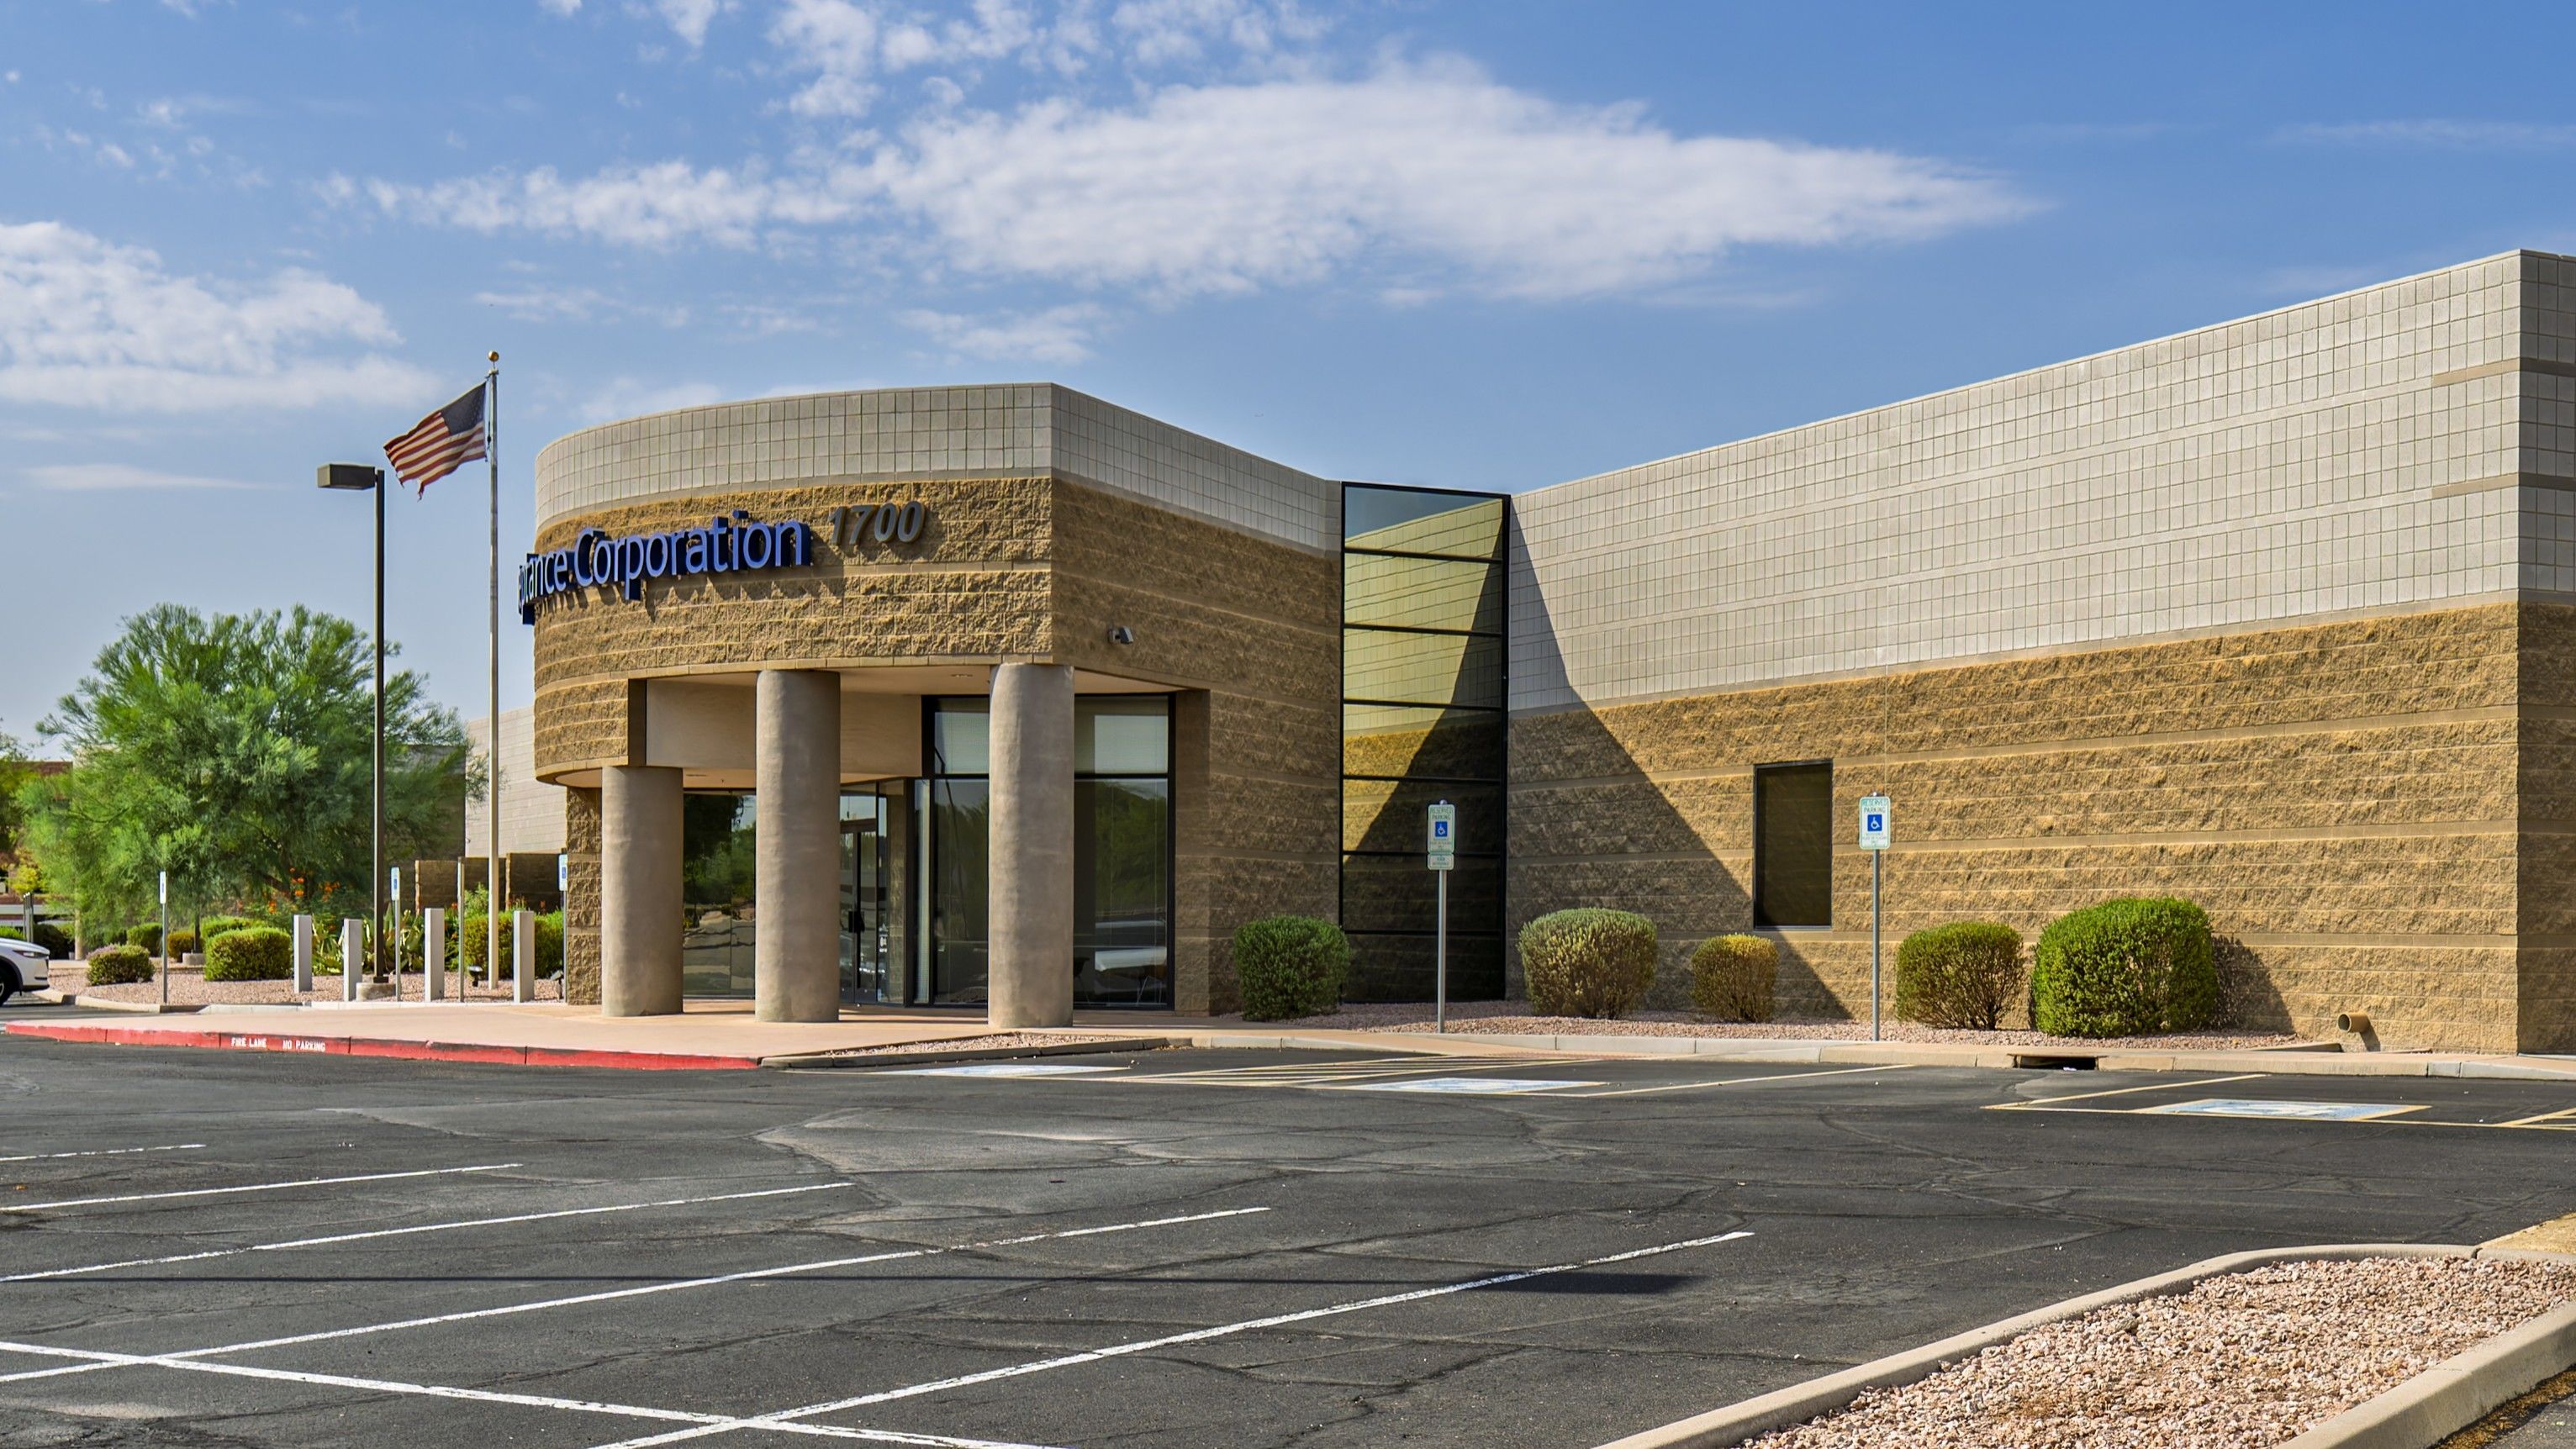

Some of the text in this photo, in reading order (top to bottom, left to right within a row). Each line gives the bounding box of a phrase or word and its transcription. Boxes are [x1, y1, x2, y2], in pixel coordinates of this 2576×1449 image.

[828, 500, 925, 547] 1700
[574, 509, 812, 600] Corporation
[230, 1037, 326, 1052] FIRE LANE NO PARKING
